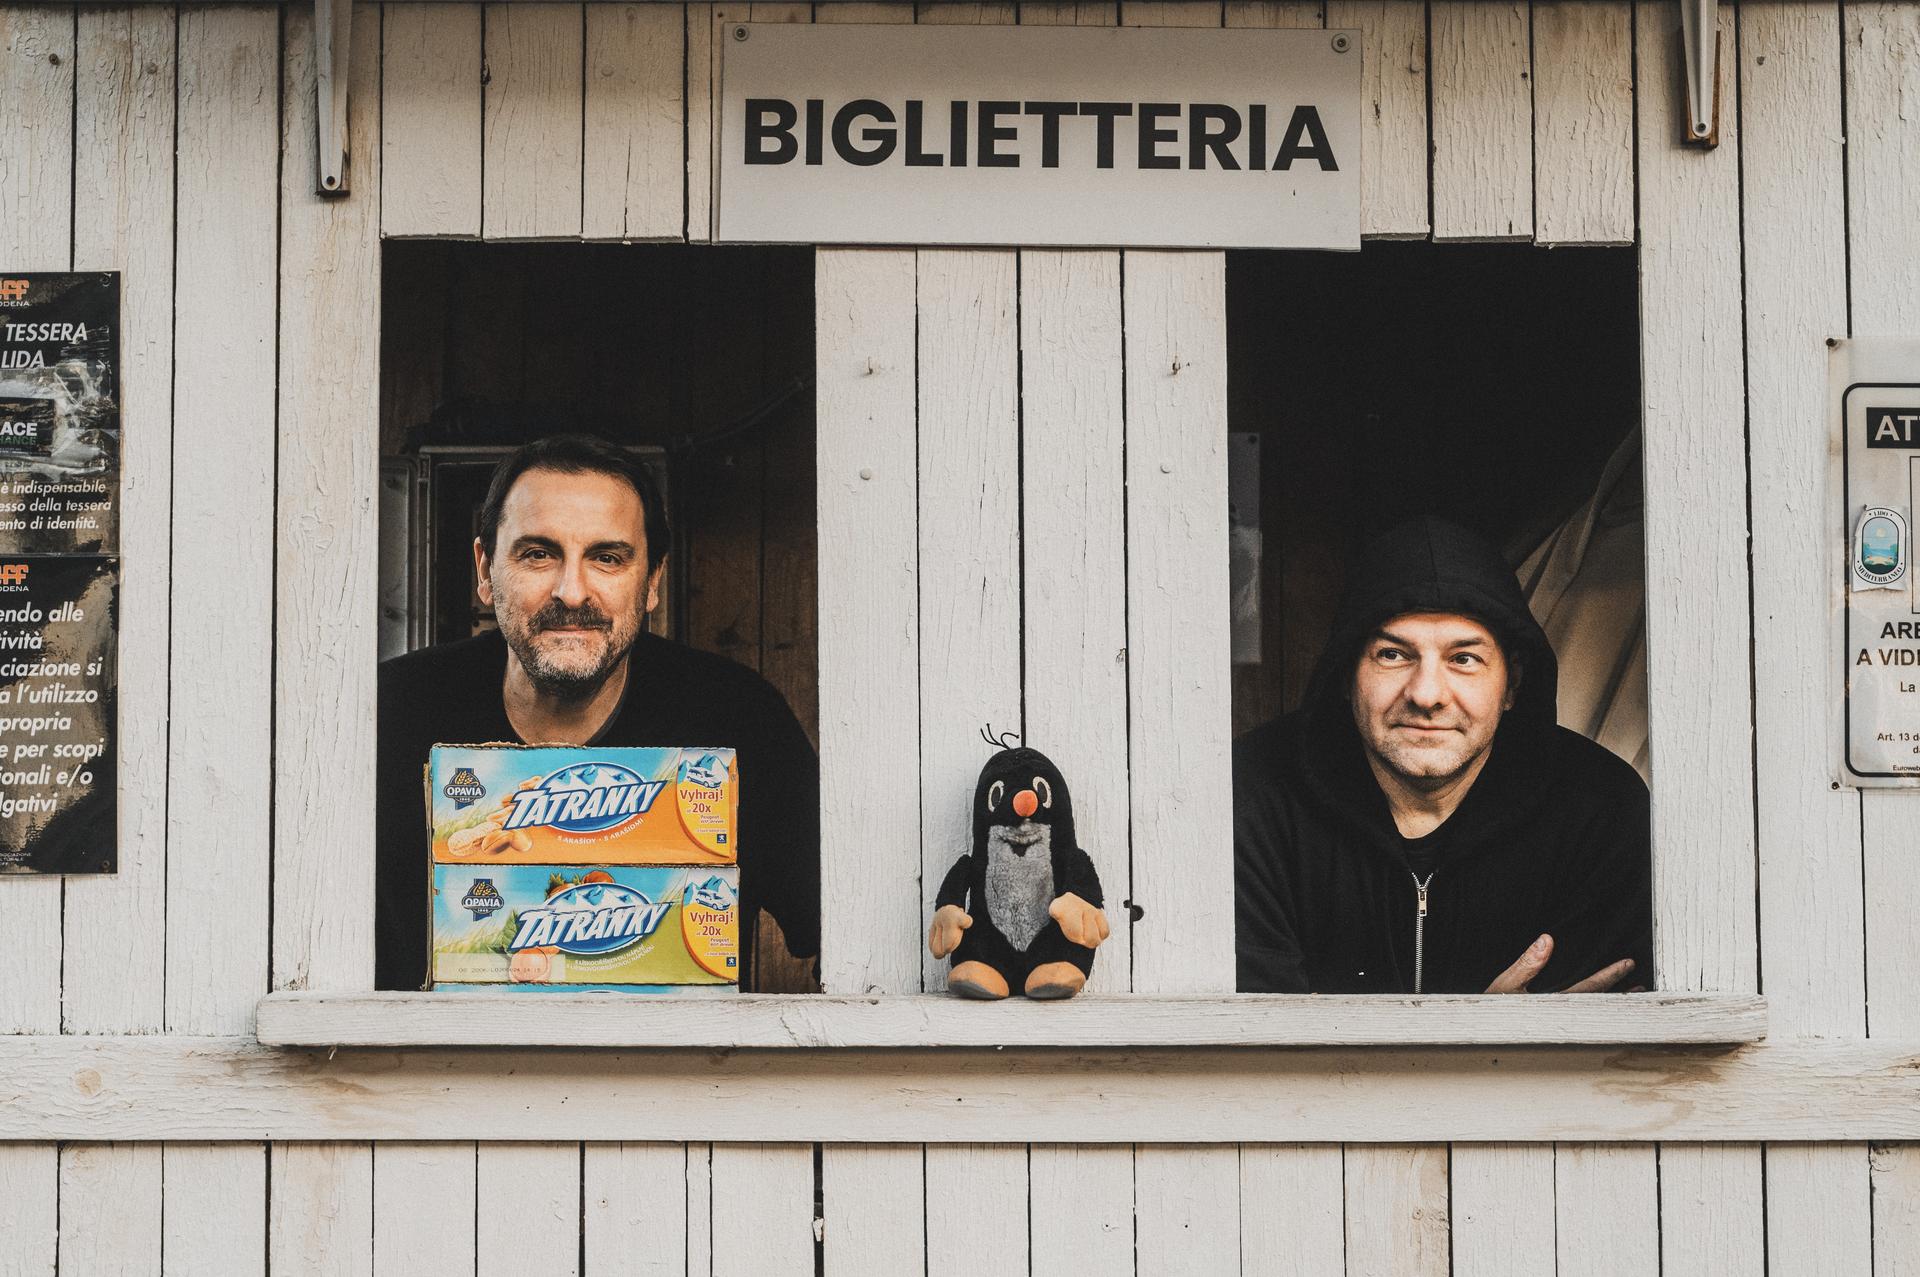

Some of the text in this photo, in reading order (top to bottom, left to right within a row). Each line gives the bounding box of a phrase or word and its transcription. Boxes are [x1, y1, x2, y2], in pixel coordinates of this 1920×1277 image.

[744, 98, 1339, 172] BIGLIETTERIA
[5, 322, 88, 341] TESSERA
[1, 350, 45, 368] LIDA
[0, 421, 38, 436] ACE
[1, 479, 106, 497] è indispensabile
[29, 498, 61, 511] della
[66, 500, 112, 511] tessera
[30, 516, 43, 529] di
[47, 515, 99, 529] identità.
[0, 564, 29, 585] ff
[48, 601, 84, 622] alle
[1856, 648, 1920, 666] A VID
[0, 656, 103, 677] ciazione si
[1900, 681, 1916, 692] La
[0, 711, 71, 736] propria
[1877, 733, 1896, 741] Art.
[1899, 733, 1910, 741] 13
[13, 744, 48, 763] per
[53, 737, 104, 763] scopi
[56, 764, 93, 787] e/o
[446, 786, 482, 796] OPAVIA
[680, 789, 723, 802] Vyhraj!
[503, 780, 667, 830] TATRANKY
[692, 803, 711, 813] 20x
[465, 898, 501, 907] OPAVIA
[510, 902, 672, 950] TATRANKY
[690, 911, 733, 925] Vyhraj!
[702, 926, 721, 936] 20x
